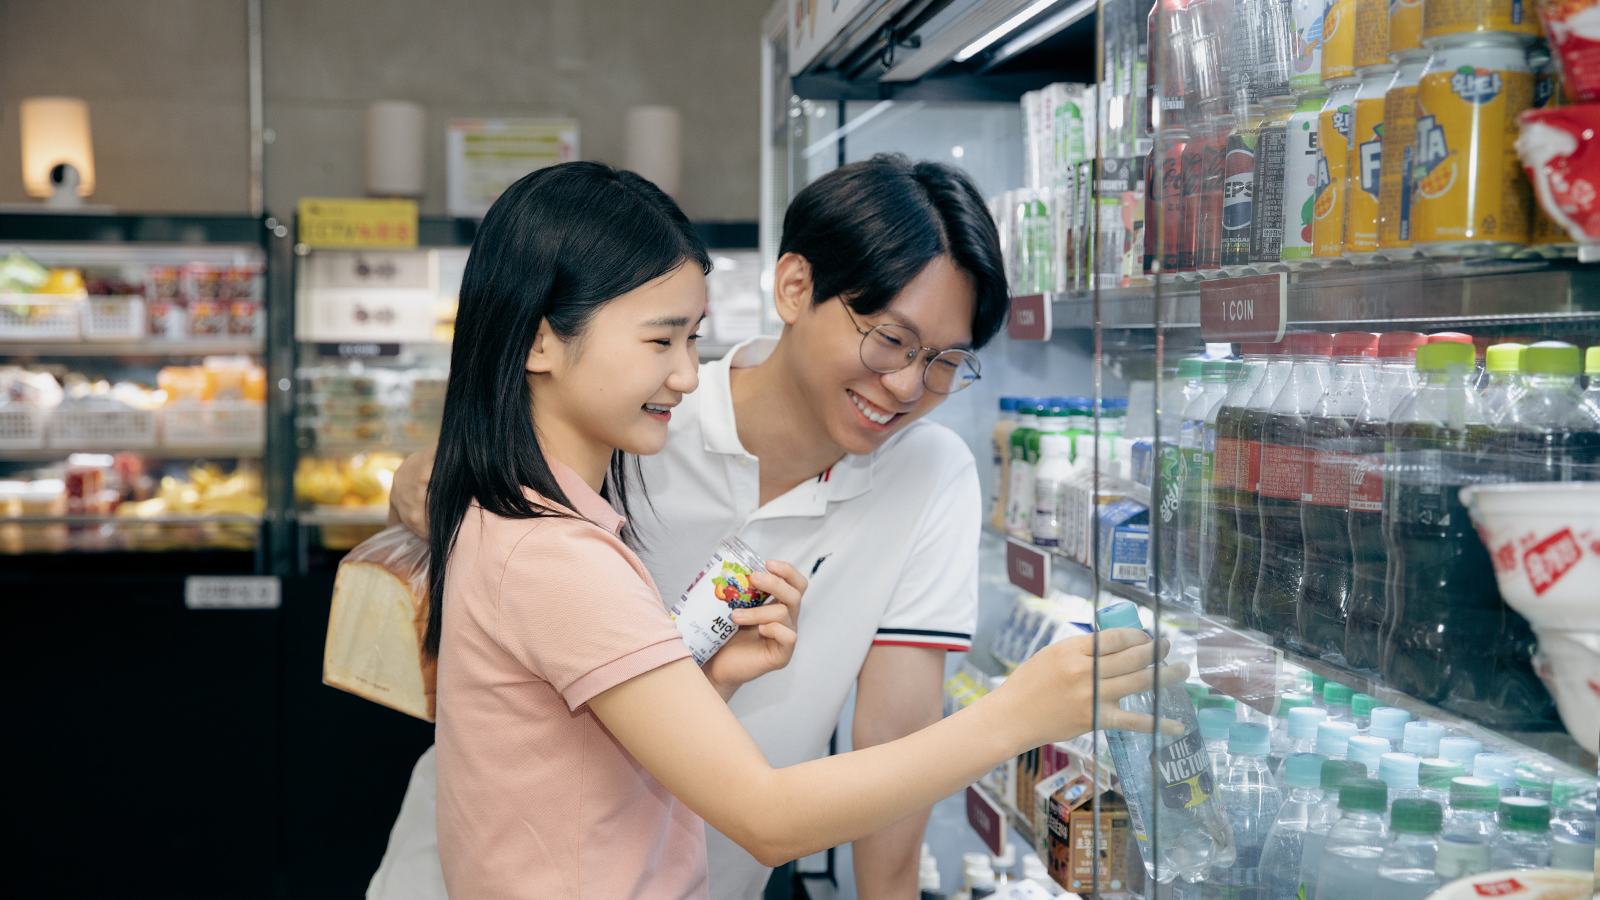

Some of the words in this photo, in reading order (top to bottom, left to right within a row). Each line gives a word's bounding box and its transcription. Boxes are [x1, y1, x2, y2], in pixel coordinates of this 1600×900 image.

[1450, 71, 1503, 96] 환타
[1222, 301, 1226, 321] 1
[1229, 299, 1254, 321] COIN
[711, 615, 736, 641] 썬업
[1167, 737, 1193, 760] THE
